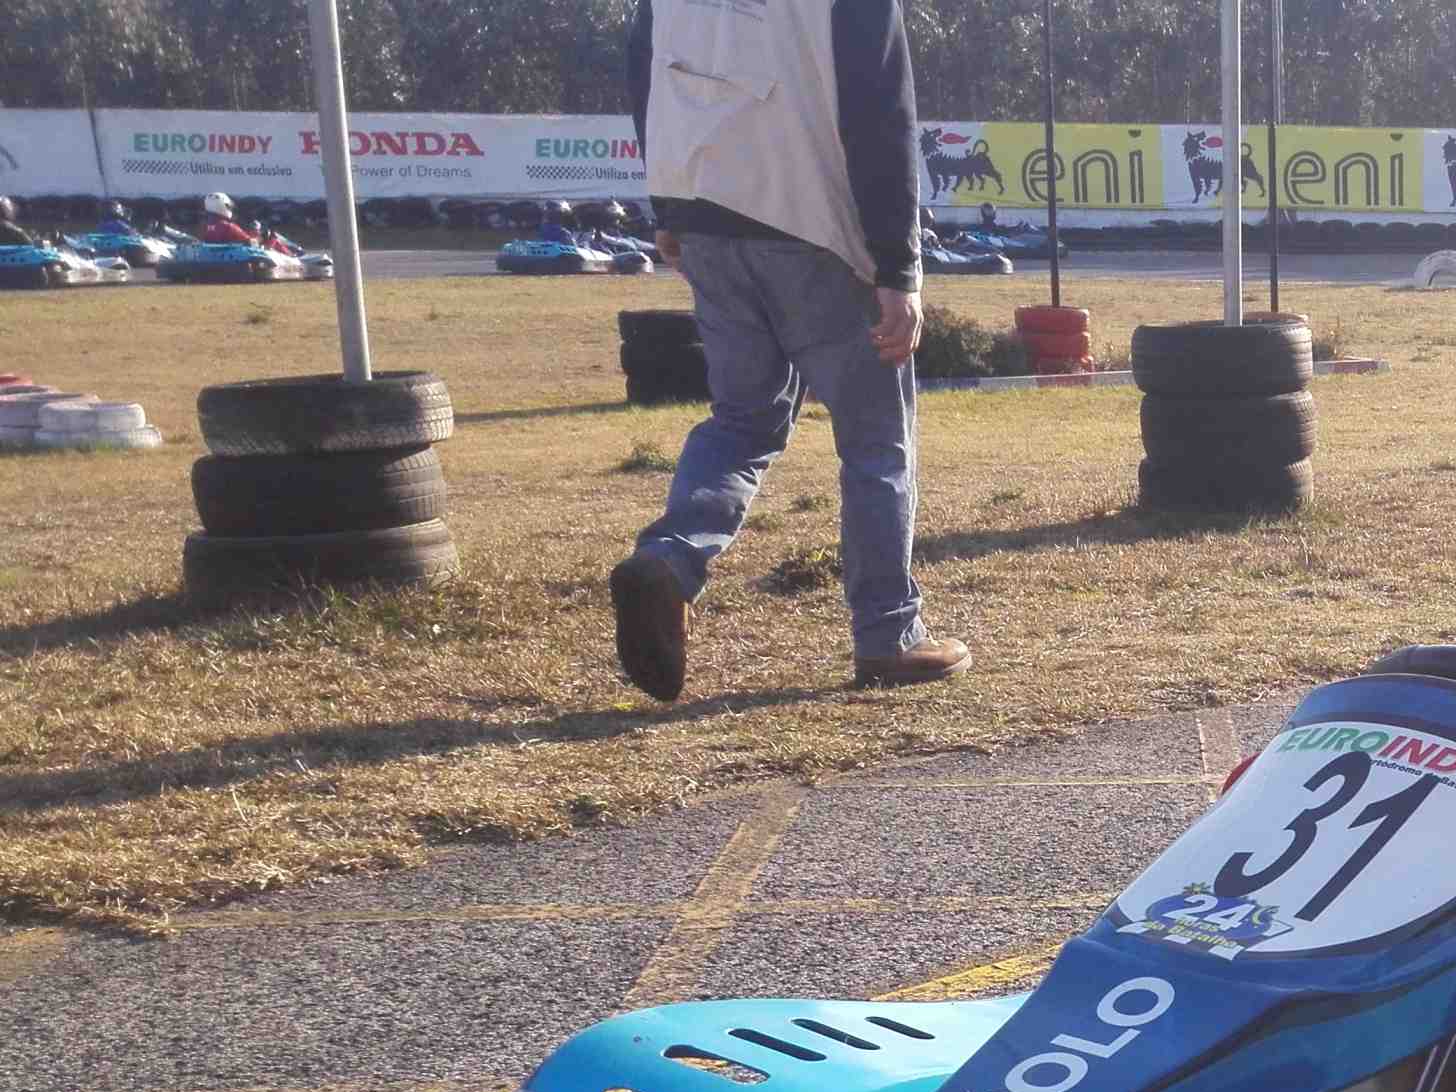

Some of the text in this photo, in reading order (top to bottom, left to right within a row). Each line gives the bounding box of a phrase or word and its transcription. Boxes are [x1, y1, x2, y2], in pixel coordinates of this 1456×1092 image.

[133, 132, 273, 155] EUROINDY
[190, 160, 226, 176] Utiliza
[227, 166, 246, 177] em
[398, 164, 414, 178] of
[416, 164, 473, 179] Dreams
[595, 167, 629, 180] Utiliza
[1022, 129, 1145, 206] eni
[1283, 130, 1404, 208] eni
[1213, 750, 1441, 923] 31
[1161, 893, 1256, 932] 24
